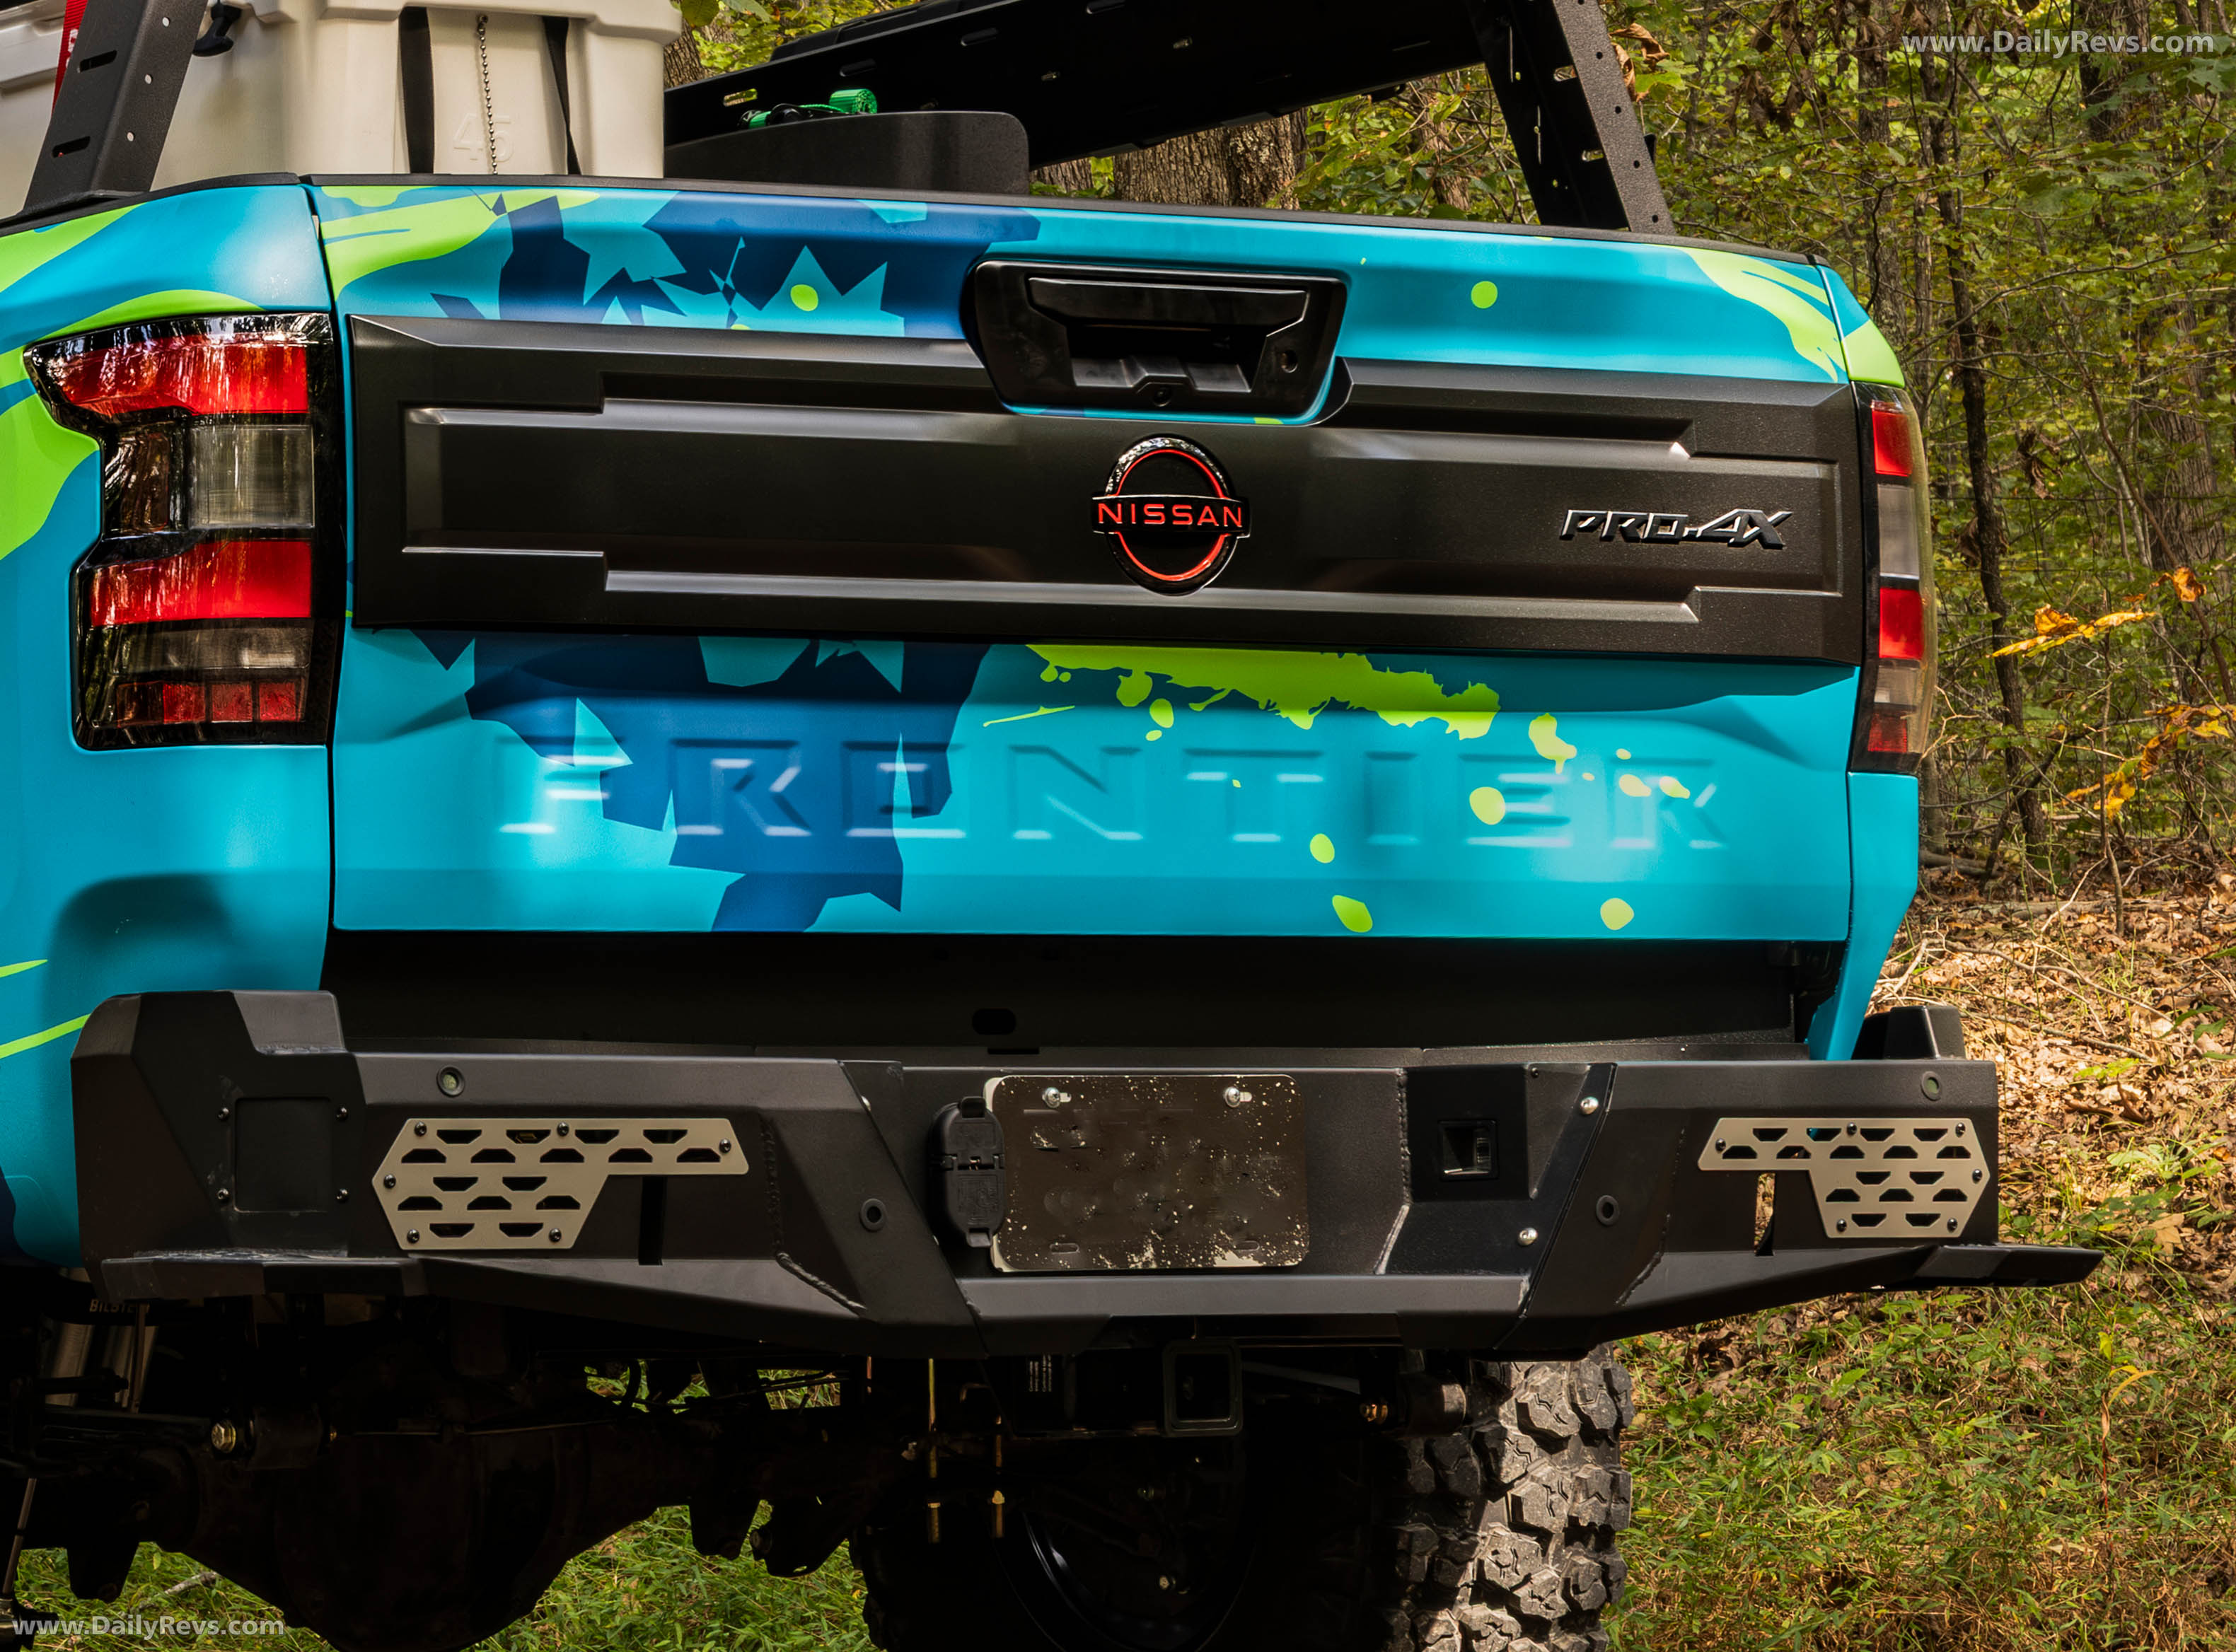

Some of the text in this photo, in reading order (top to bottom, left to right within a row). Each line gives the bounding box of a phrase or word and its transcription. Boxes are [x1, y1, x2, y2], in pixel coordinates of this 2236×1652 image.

[453, 113, 515, 163] 45
[1098, 503, 1243, 528] NISSAN
[1559, 508, 1793, 549] PRO-4X
[497, 735, 1720, 849] FRONTIER
